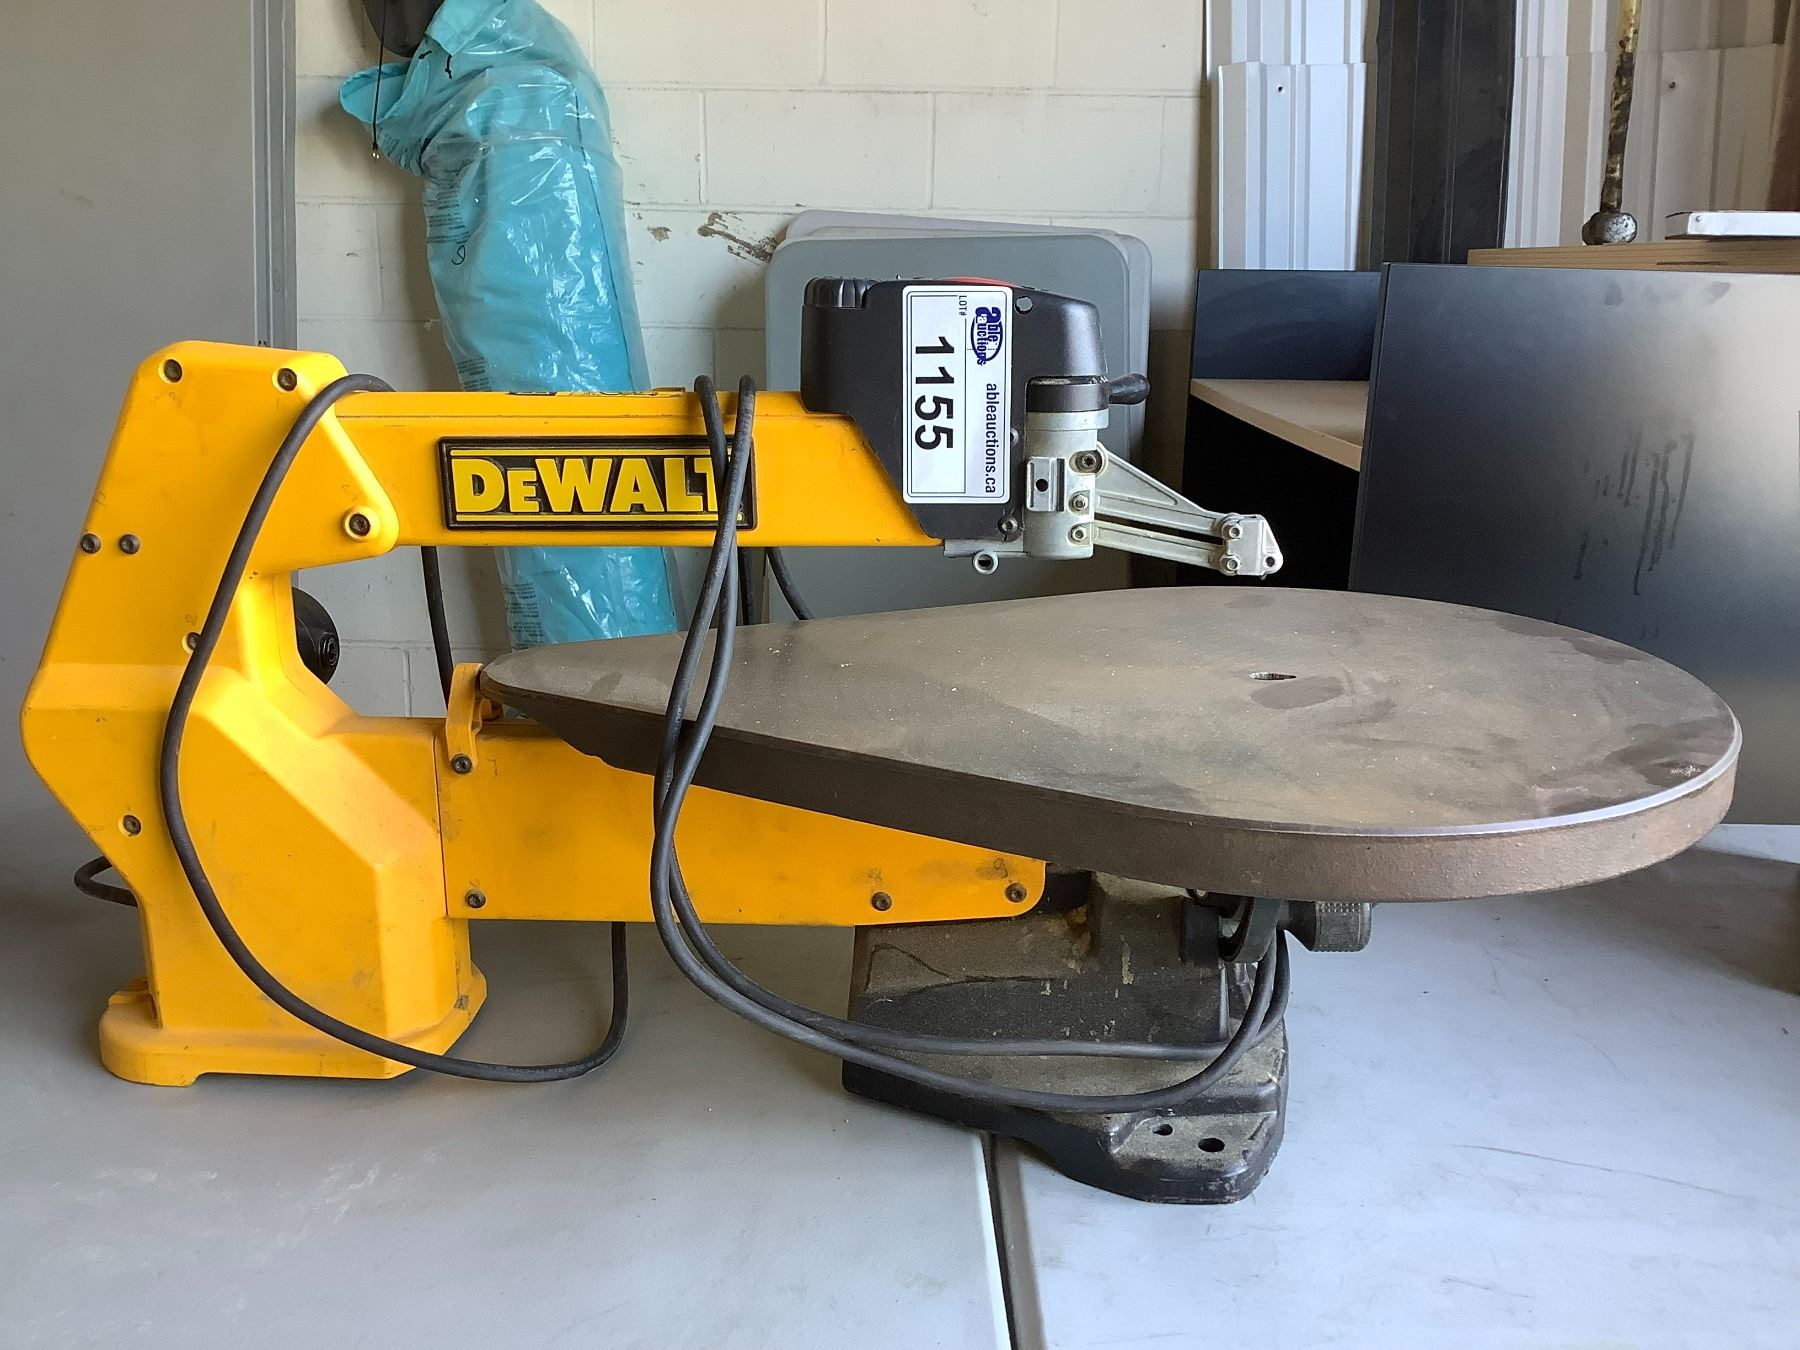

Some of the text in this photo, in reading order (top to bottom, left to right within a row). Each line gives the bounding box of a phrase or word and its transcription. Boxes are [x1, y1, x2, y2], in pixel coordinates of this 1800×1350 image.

[958, 295, 967, 317] LOT#
[914, 336, 955, 450] 1155
[985, 383, 1000, 494] ableauctions.ca
